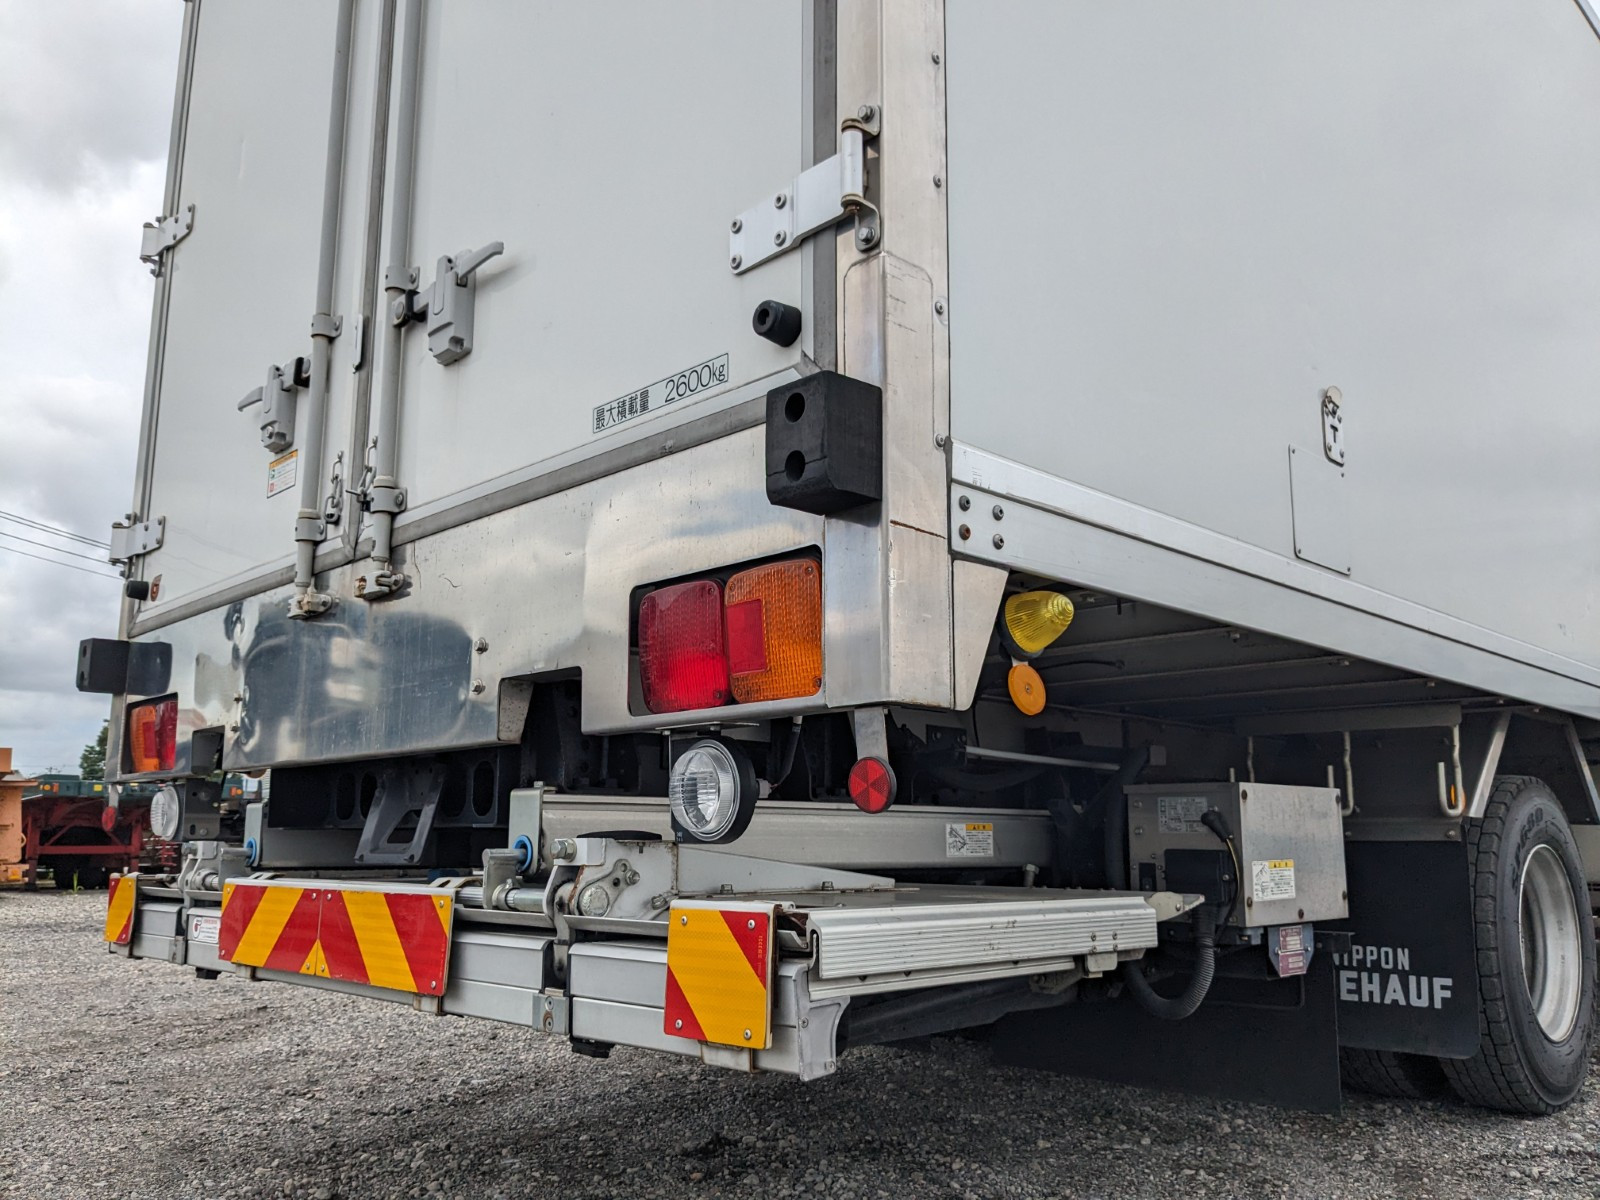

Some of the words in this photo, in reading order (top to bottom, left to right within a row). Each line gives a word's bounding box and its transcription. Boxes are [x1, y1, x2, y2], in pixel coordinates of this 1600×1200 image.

[595, 389, 650, 430] 最大積載量
[664, 362, 726, 403] 2600kg
[1339, 970, 1453, 1009] EHAUF
